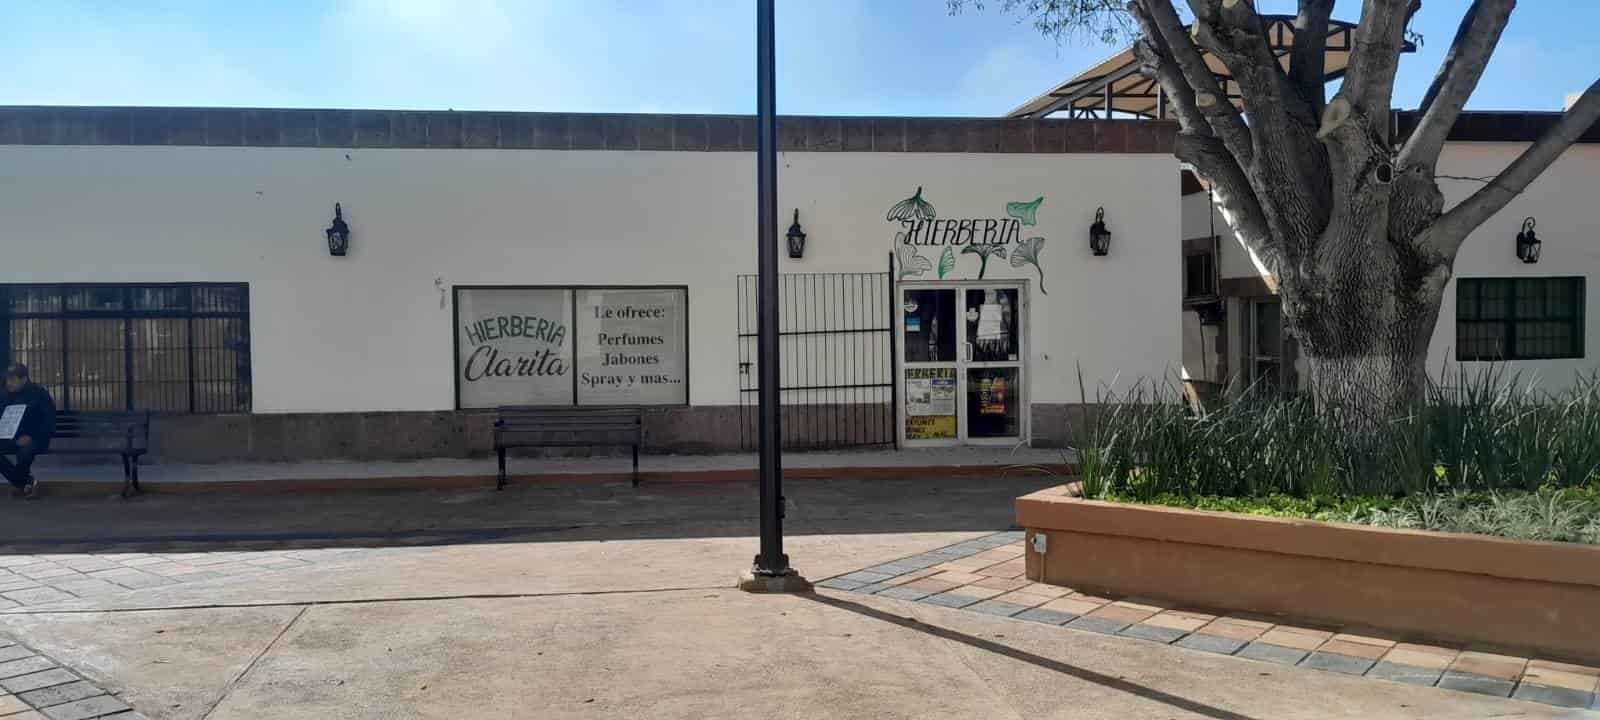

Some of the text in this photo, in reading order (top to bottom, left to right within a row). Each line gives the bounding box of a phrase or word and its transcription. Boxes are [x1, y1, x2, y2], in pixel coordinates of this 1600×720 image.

[901, 218, 1021, 246] HIERBERIA
[594, 306, 665, 318] Le ofrece:
[465, 315, 566, 346] HIERBERIA
[598, 333, 664, 345] Perfumes
[464, 345, 569, 382] Clarita
[602, 353, 659, 366] Jabones
[581, 372, 681, 388] Spray y mas...
